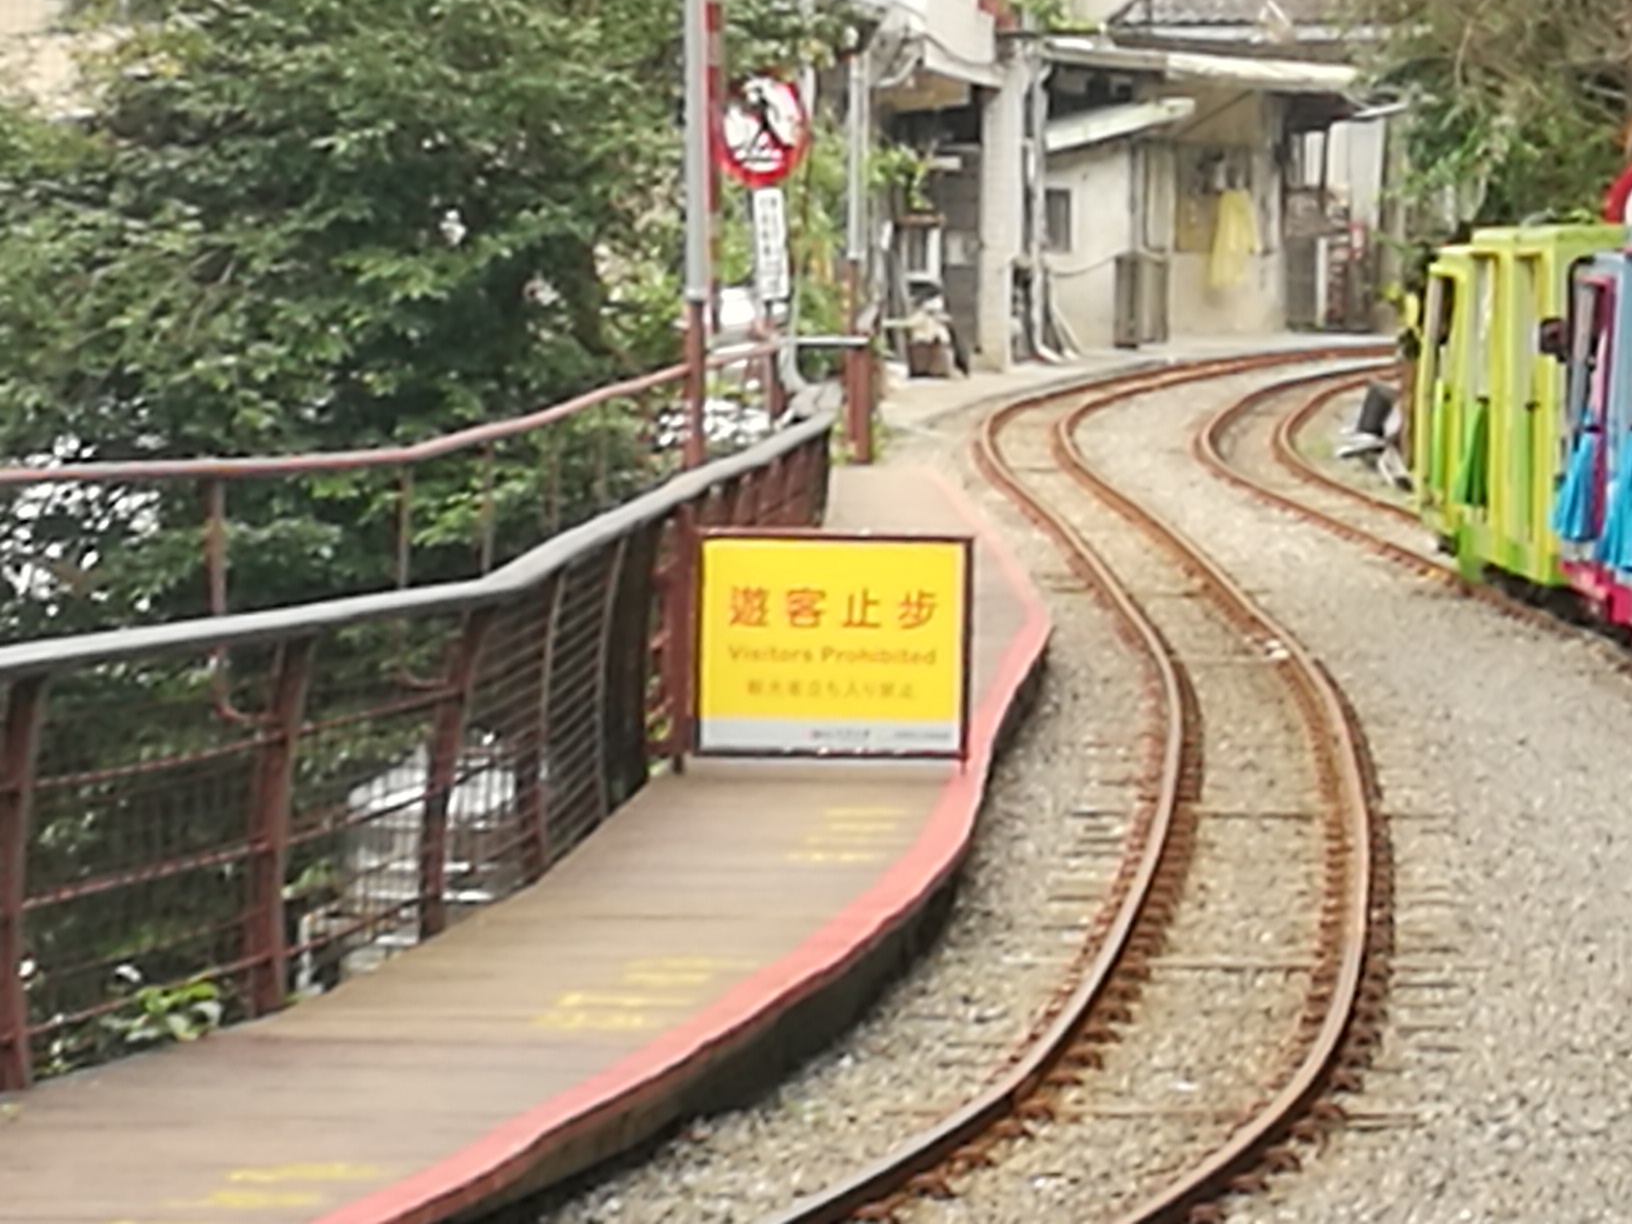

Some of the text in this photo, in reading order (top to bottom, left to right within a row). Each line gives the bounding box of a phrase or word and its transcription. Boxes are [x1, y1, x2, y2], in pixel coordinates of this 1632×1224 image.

[727, 585, 938, 631] 遊客止步
[728, 644, 937, 666] Visitors Prohibited
